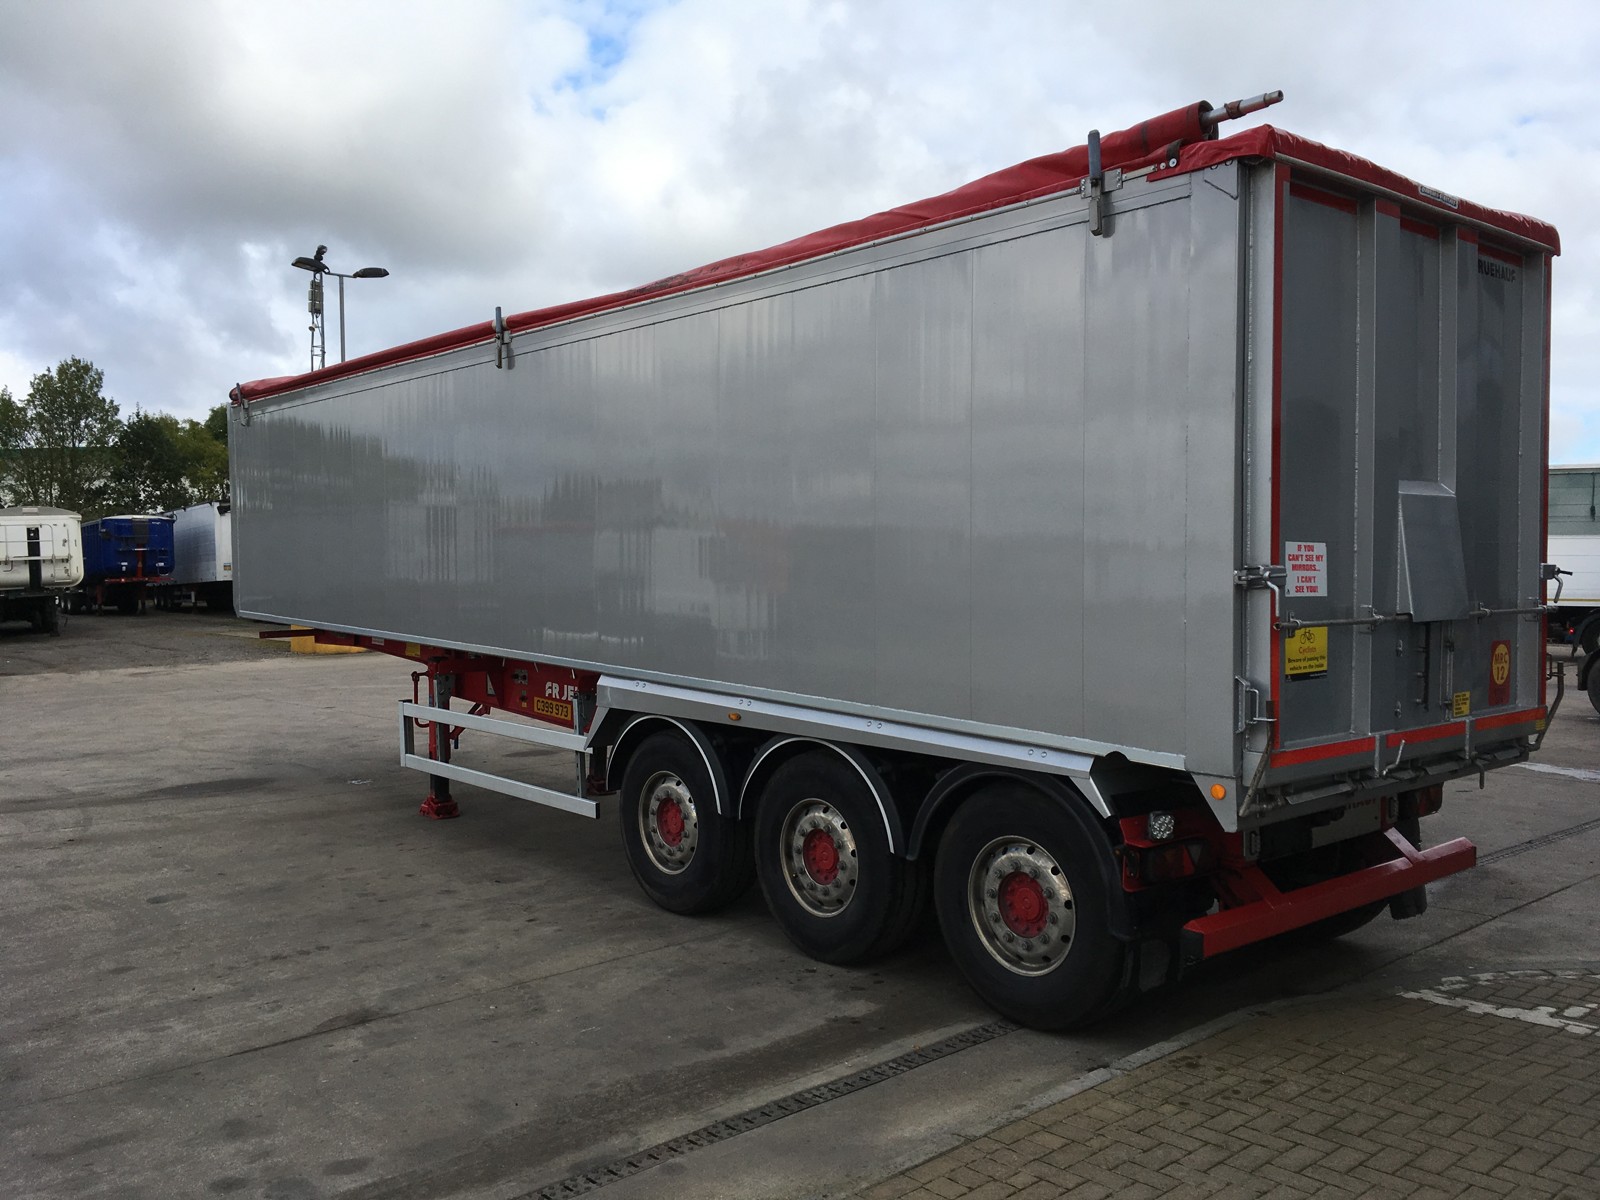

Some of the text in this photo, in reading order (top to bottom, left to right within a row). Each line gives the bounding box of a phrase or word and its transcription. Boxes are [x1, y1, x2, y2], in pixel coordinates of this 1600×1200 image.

[1478, 259, 1516, 282] RUEHAUF
[1297, 544, 1314, 552] IF YOU
[1305, 554, 1314, 562] SEE
[1315, 554, 1324, 562] MY
[1301, 575, 1316, 583] CAN'T
[1295, 585, 1305, 593] SEE
[1494, 651, 1508, 665] MRC
[1496, 666, 1506, 681] 12
[555, 704, 568, 717] 973
